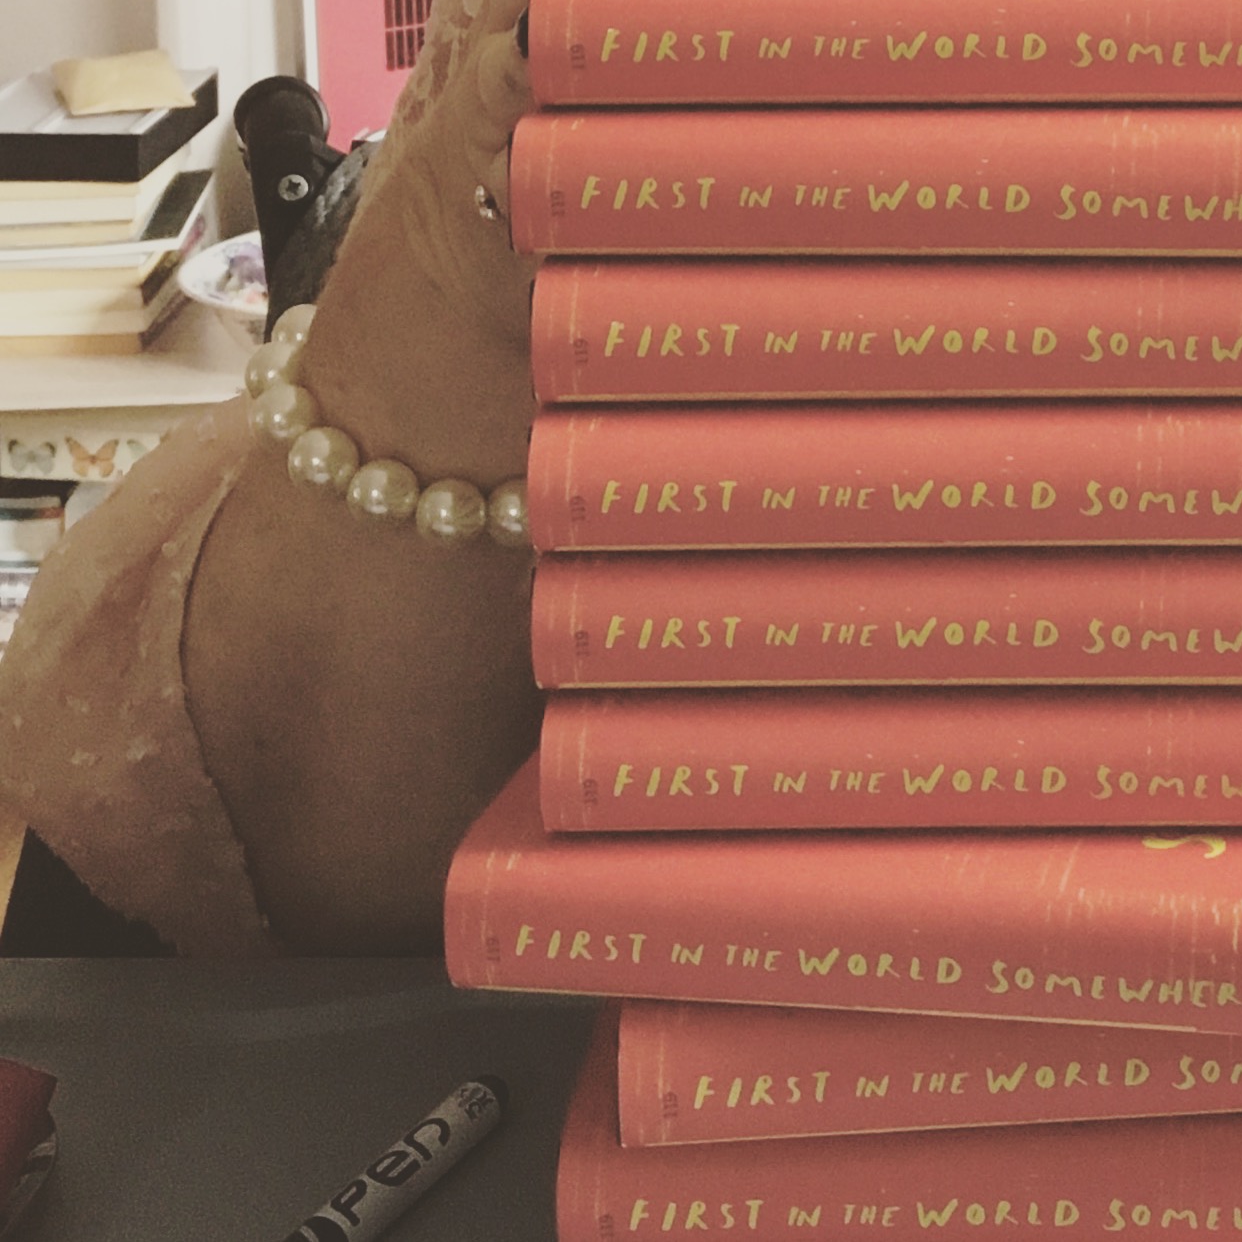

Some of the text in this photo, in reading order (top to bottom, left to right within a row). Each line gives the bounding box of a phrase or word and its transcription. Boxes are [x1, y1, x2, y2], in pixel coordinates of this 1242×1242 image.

[601, 28, 734, 62] FIRST
[759, 38, 791, 58] IN
[815, 37, 868, 59] THE
[887, 32, 1046, 61] WORLD
[581, 176, 715, 209] FIRST
[739, 186, 772, 207] IN
[796, 185, 850, 209] THE
[869, 181, 1030, 212] WORLD
[605, 321, 739, 357] FIRST
[765, 331, 797, 353] IN
[821, 330, 876, 354] THE
[894, 325, 1056, 355] WORLD
[602, 480, 737, 513] FIRST
[763, 488, 795, 509] IN
[820, 486, 874, 509] THE
[893, 480, 1056, 511] WORLD
[606, 615, 741, 649] FIRST
[766, 624, 799, 646] IN
[822, 623, 877, 646] THE
[896, 617, 1058, 648] WORLD
[614, 763, 748, 797] FIRST
[774, 772, 806, 793] IN
[830, 770, 884, 793] THE
[904, 765, 1066, 795] WORLD
[516, 925, 646, 963] FIRST
[671, 944, 704, 965] IN
[727, 945, 781, 971] THE
[799, 948, 962, 985] WORLD
[694, 1072, 830, 1109] FIRST
[856, 1075, 889, 1097] IN
[913, 1073, 968, 1094] THE
[987, 1059, 1149, 1094] WORLD
[630, 1199, 763, 1231] FIRST
[788, 1206, 821, 1227] IN
[844, 1204, 900, 1227] THE
[917, 1199, 1079, 1228] WORLD
